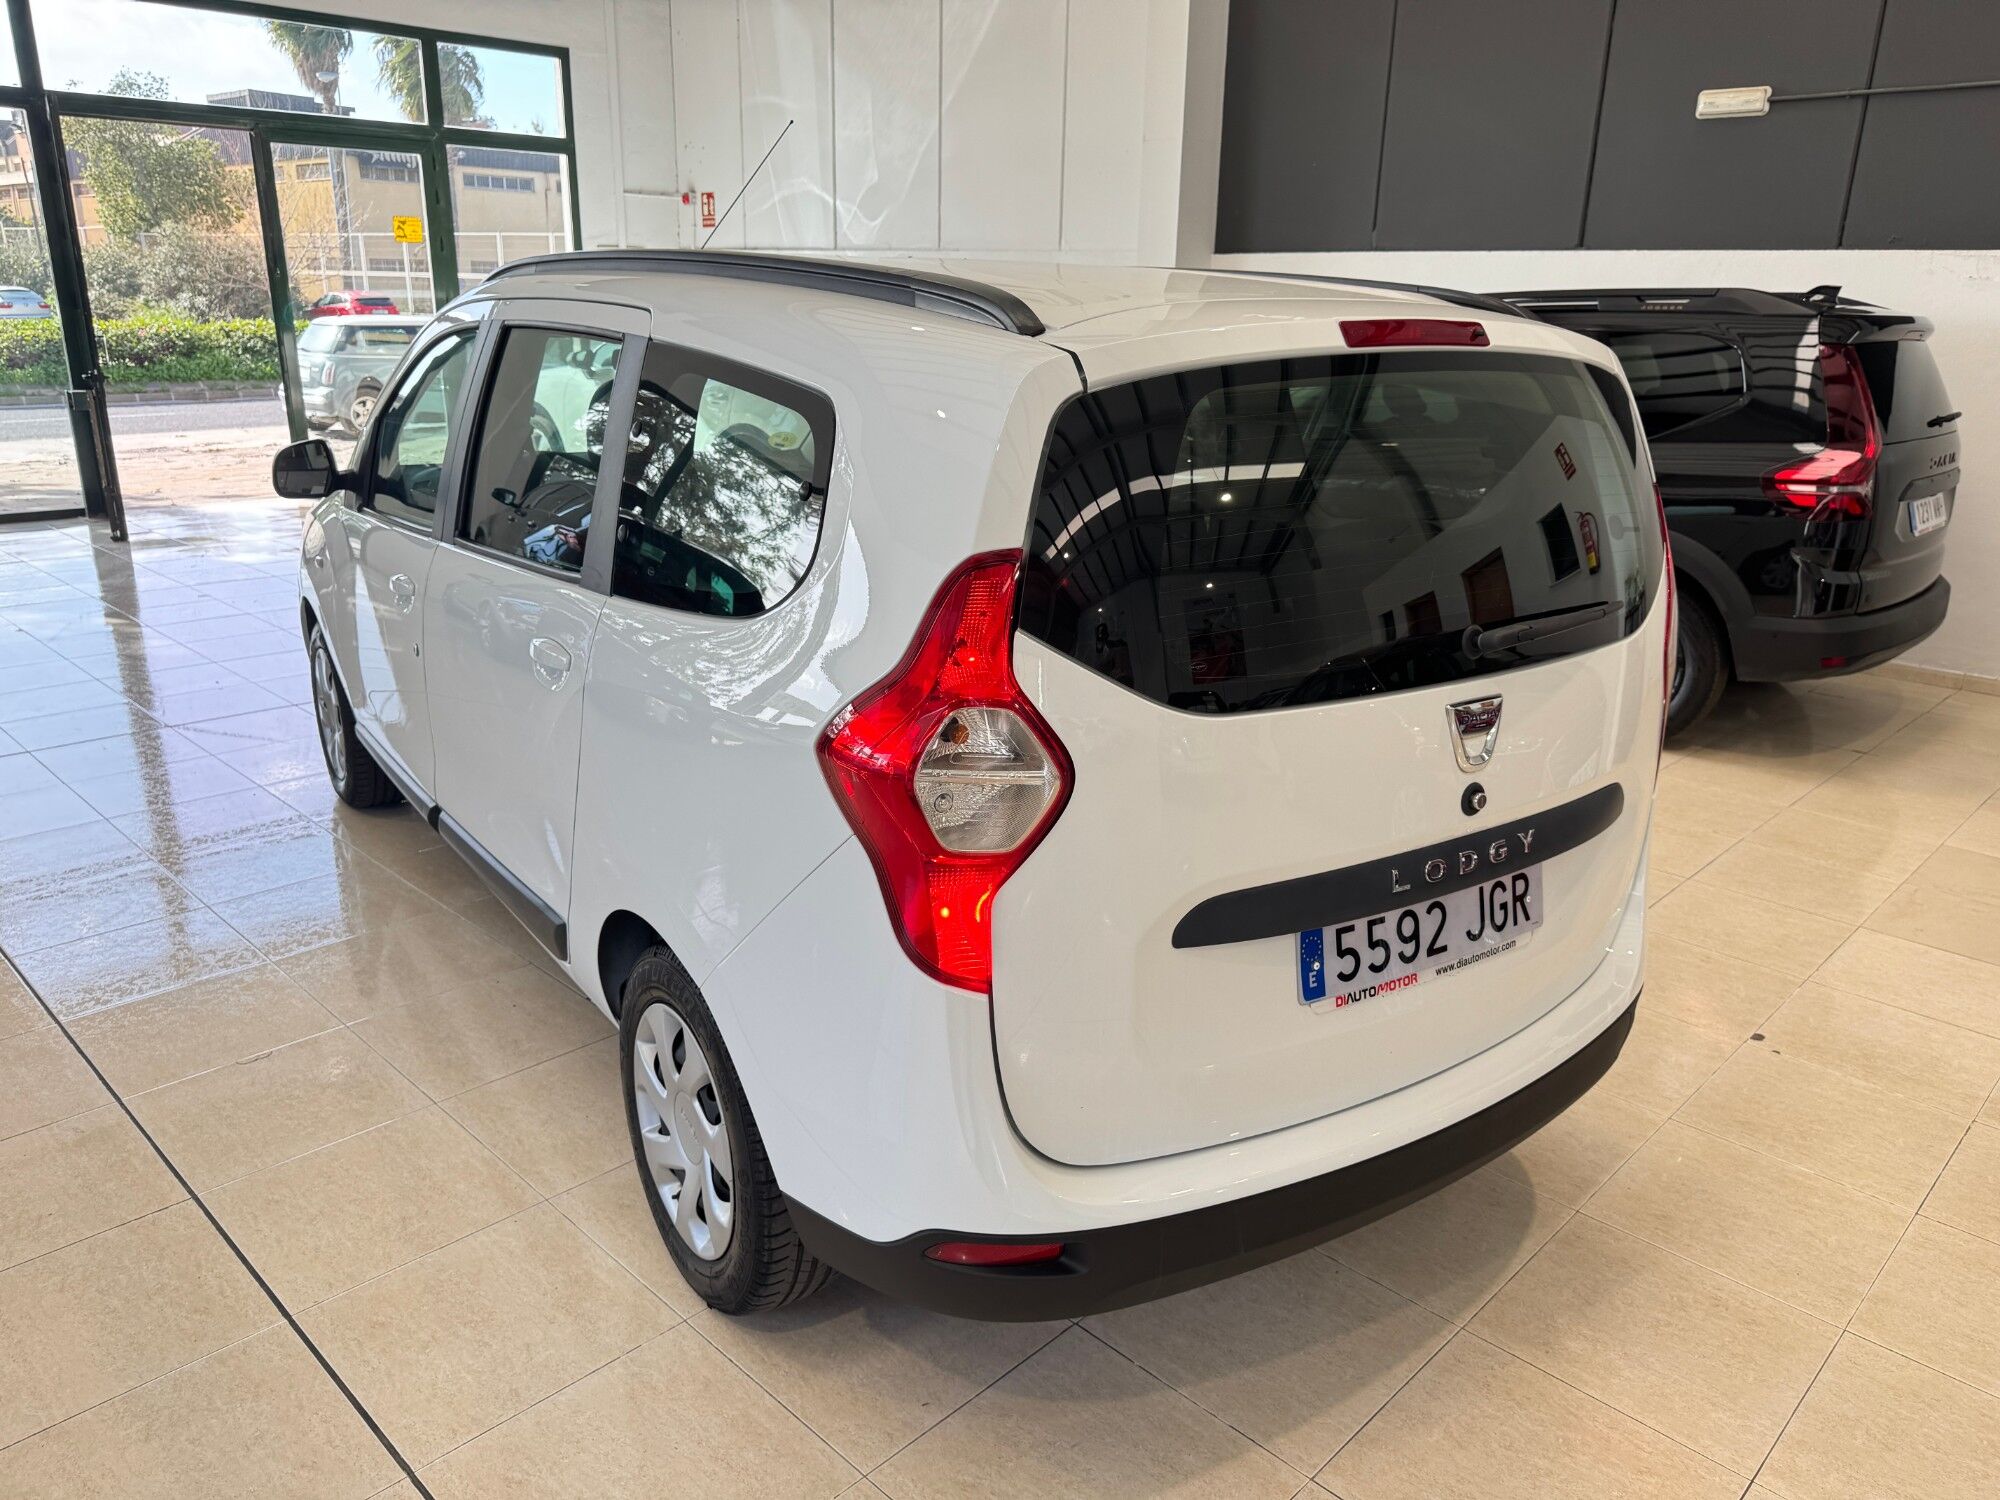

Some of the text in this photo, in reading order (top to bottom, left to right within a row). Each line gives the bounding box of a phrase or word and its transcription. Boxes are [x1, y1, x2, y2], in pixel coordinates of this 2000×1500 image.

[1391, 828, 1535, 894] LODGY
[1336, 872, 1531, 982] 5592 JGR
[1309, 970, 1318, 988] E
[1435, 939, 1516, 976] www.diautomotor.com
